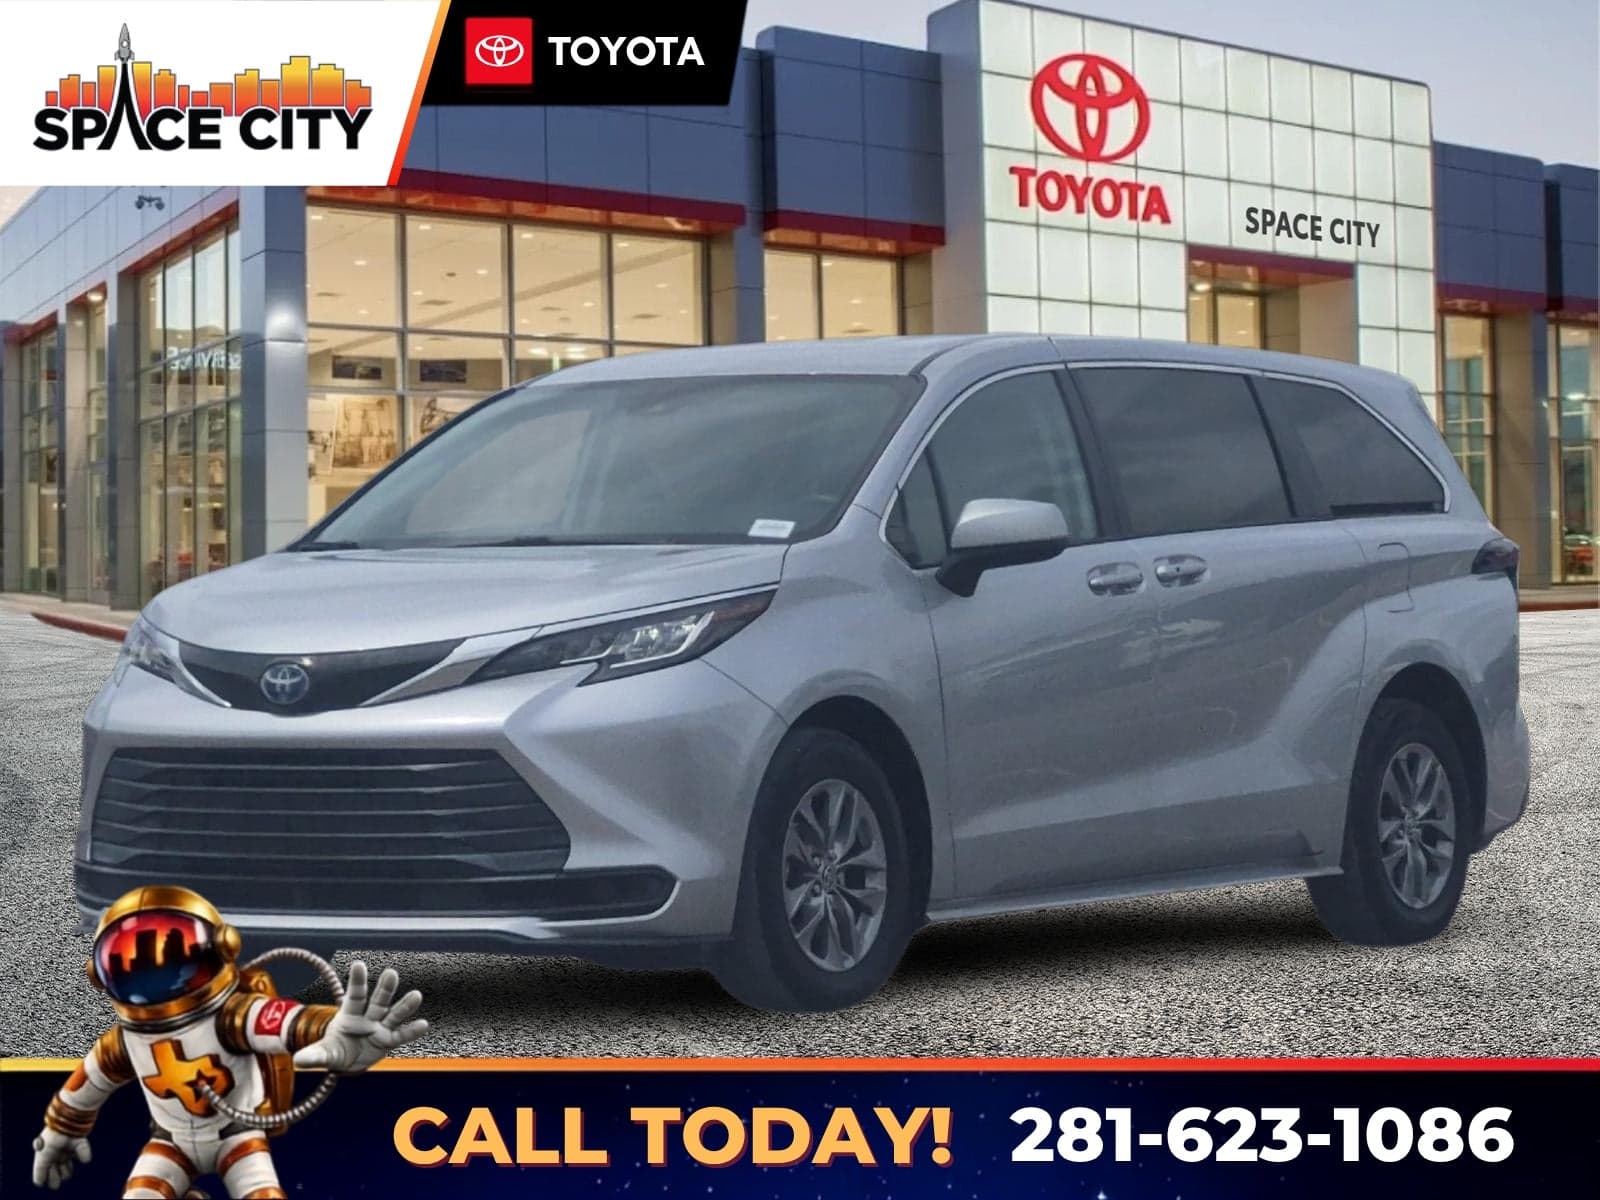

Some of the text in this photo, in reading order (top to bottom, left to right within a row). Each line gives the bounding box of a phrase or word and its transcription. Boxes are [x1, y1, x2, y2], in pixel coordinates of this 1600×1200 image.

[1009, 165, 1172, 225] TOYOTA
[1245, 206, 1381, 249] SPACE CITY
